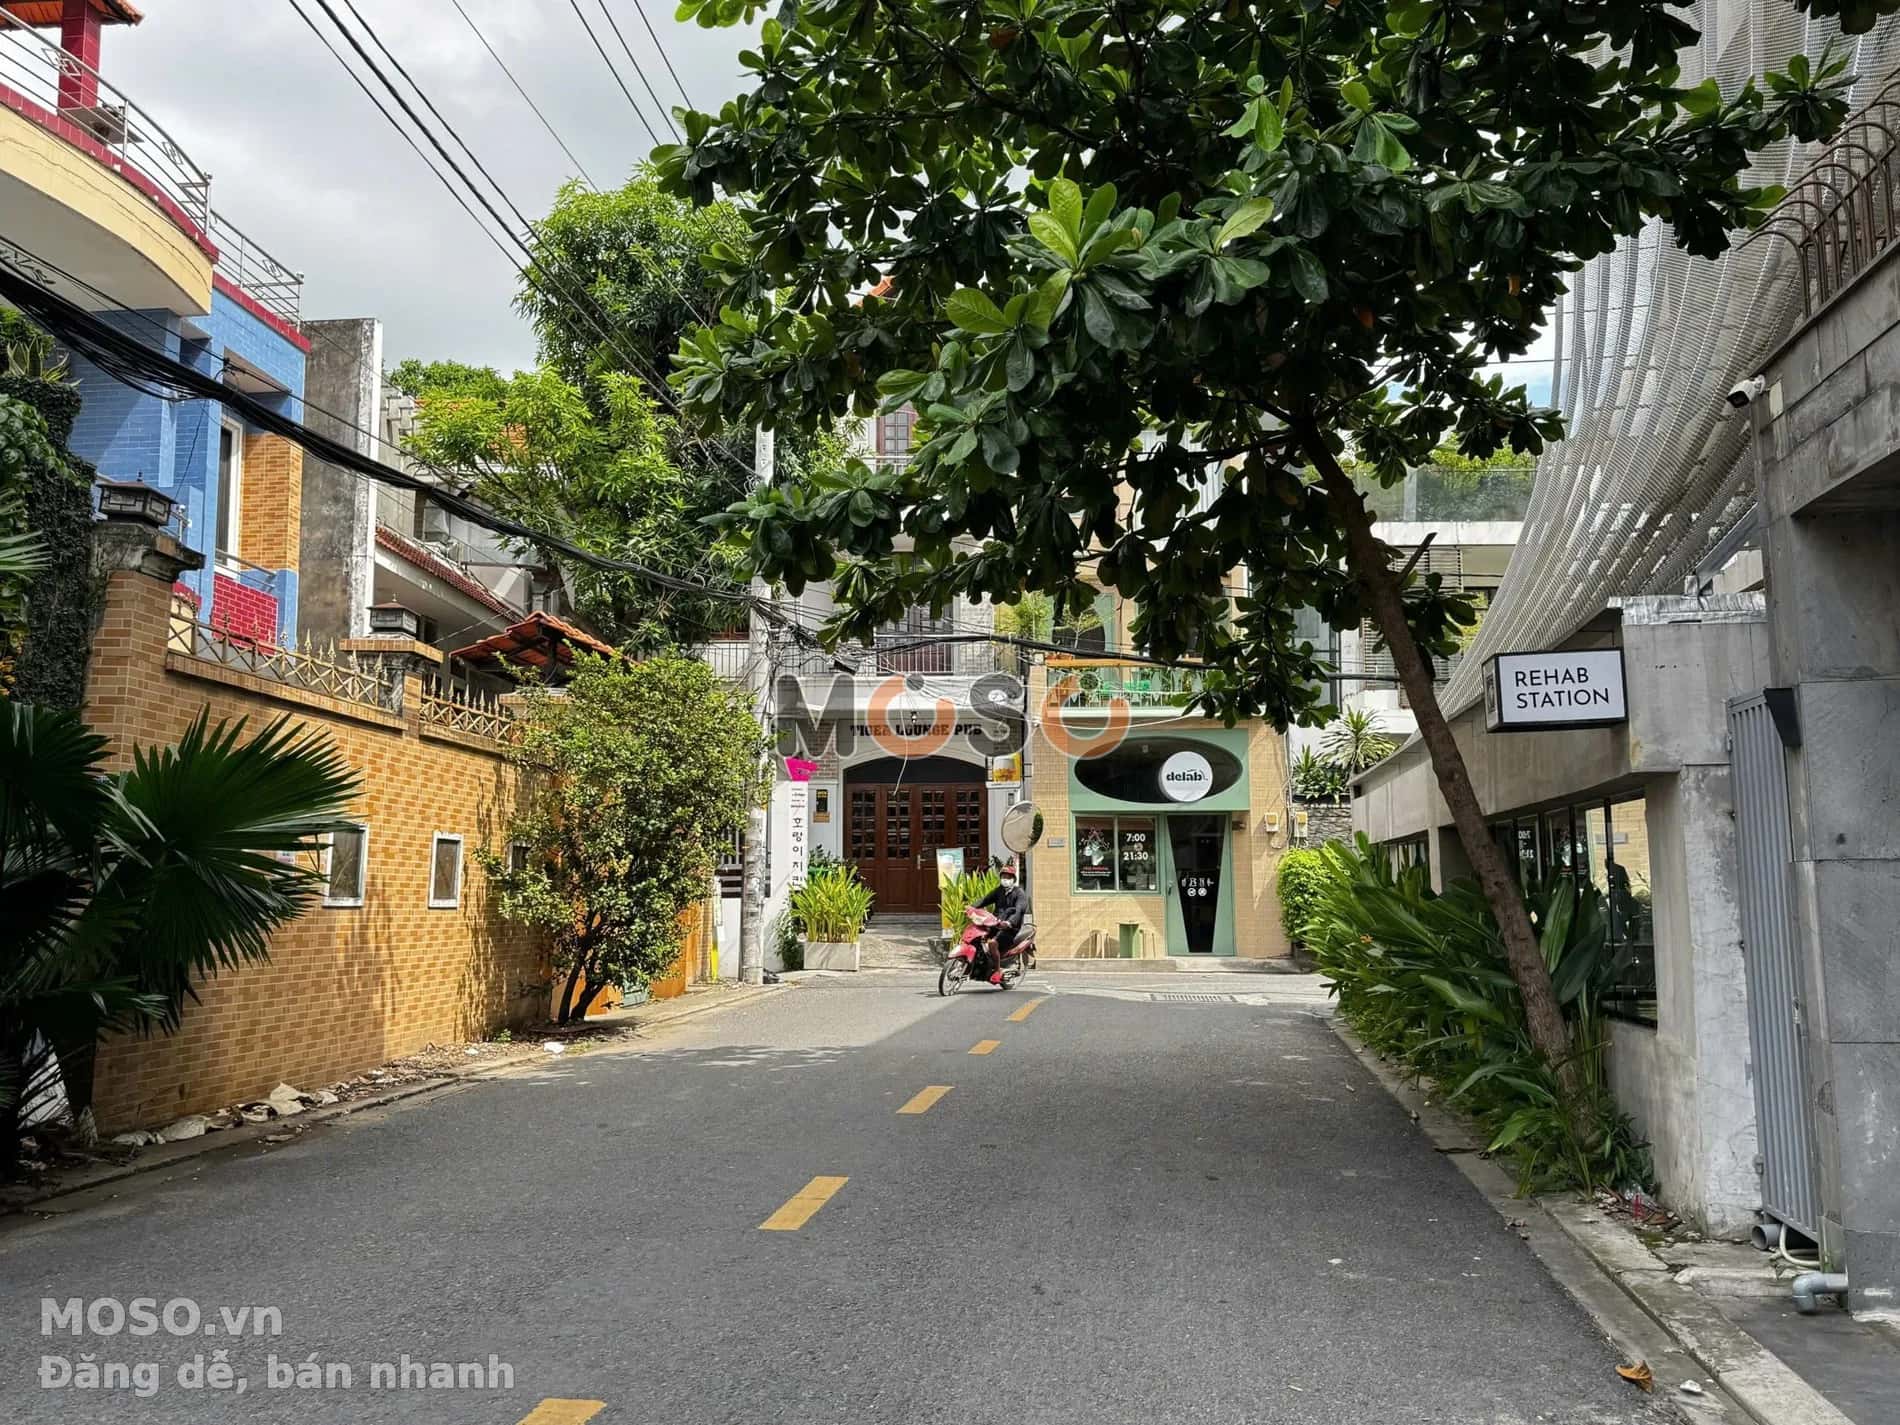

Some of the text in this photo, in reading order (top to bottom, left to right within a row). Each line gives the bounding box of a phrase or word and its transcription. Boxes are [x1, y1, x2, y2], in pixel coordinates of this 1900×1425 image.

[1515, 667, 1590, 688] REHAB
[1516, 687, 1610, 709] STATION
[895, 724, 950, 736] LOUNGE
[954, 723, 982, 736] PUB
[1166, 769, 1203, 782] delab
[1126, 832, 1146, 842] 7:00
[1123, 851, 1149, 861] 21:30
